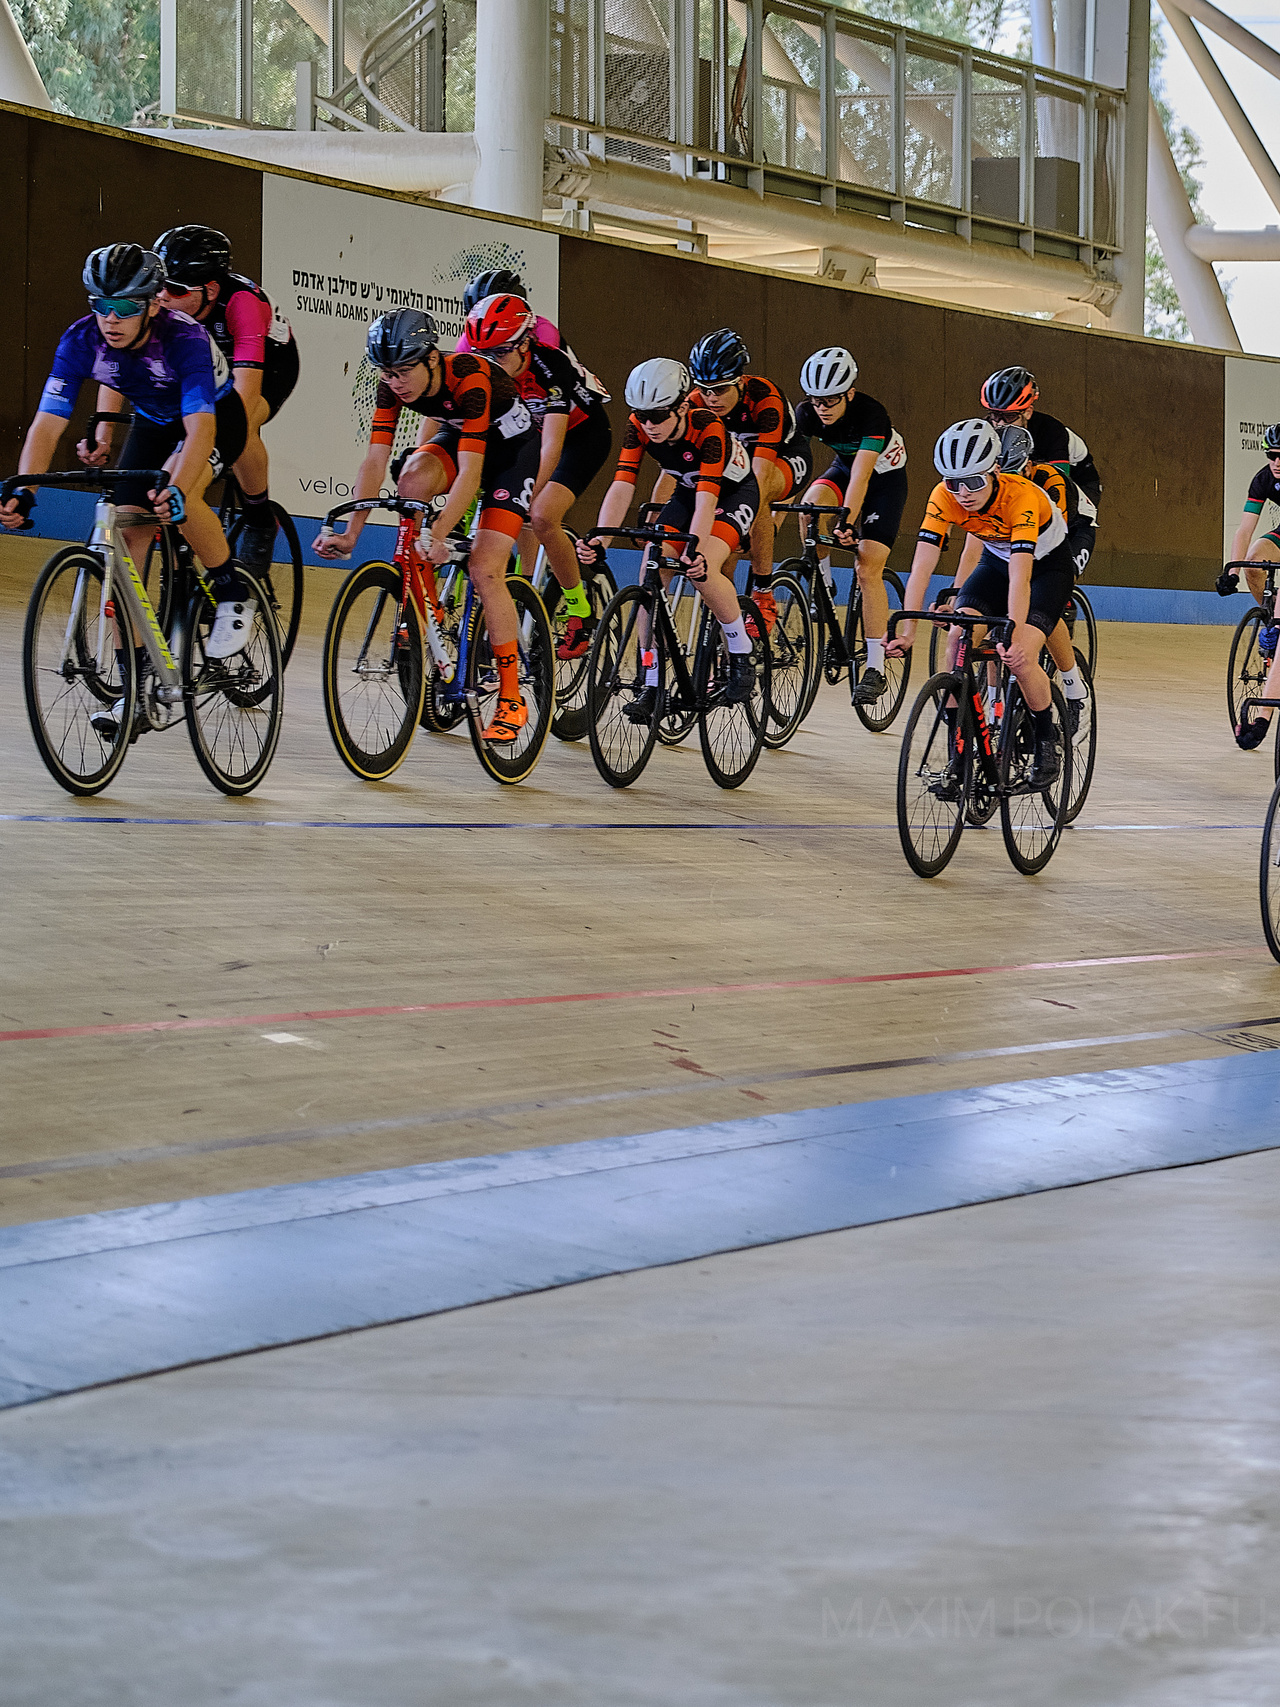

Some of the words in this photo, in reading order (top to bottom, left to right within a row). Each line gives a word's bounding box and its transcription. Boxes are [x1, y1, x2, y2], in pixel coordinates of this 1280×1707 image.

[292, 269, 325, 288] אדמס
[327, 274, 358, 297] סילבן
[296, 294, 333, 317] SYLVAN
[335, 302, 369, 323] ADAMS
[386, 286, 424, 310] הלאומי
[122, 555, 177, 670] MERIDA
